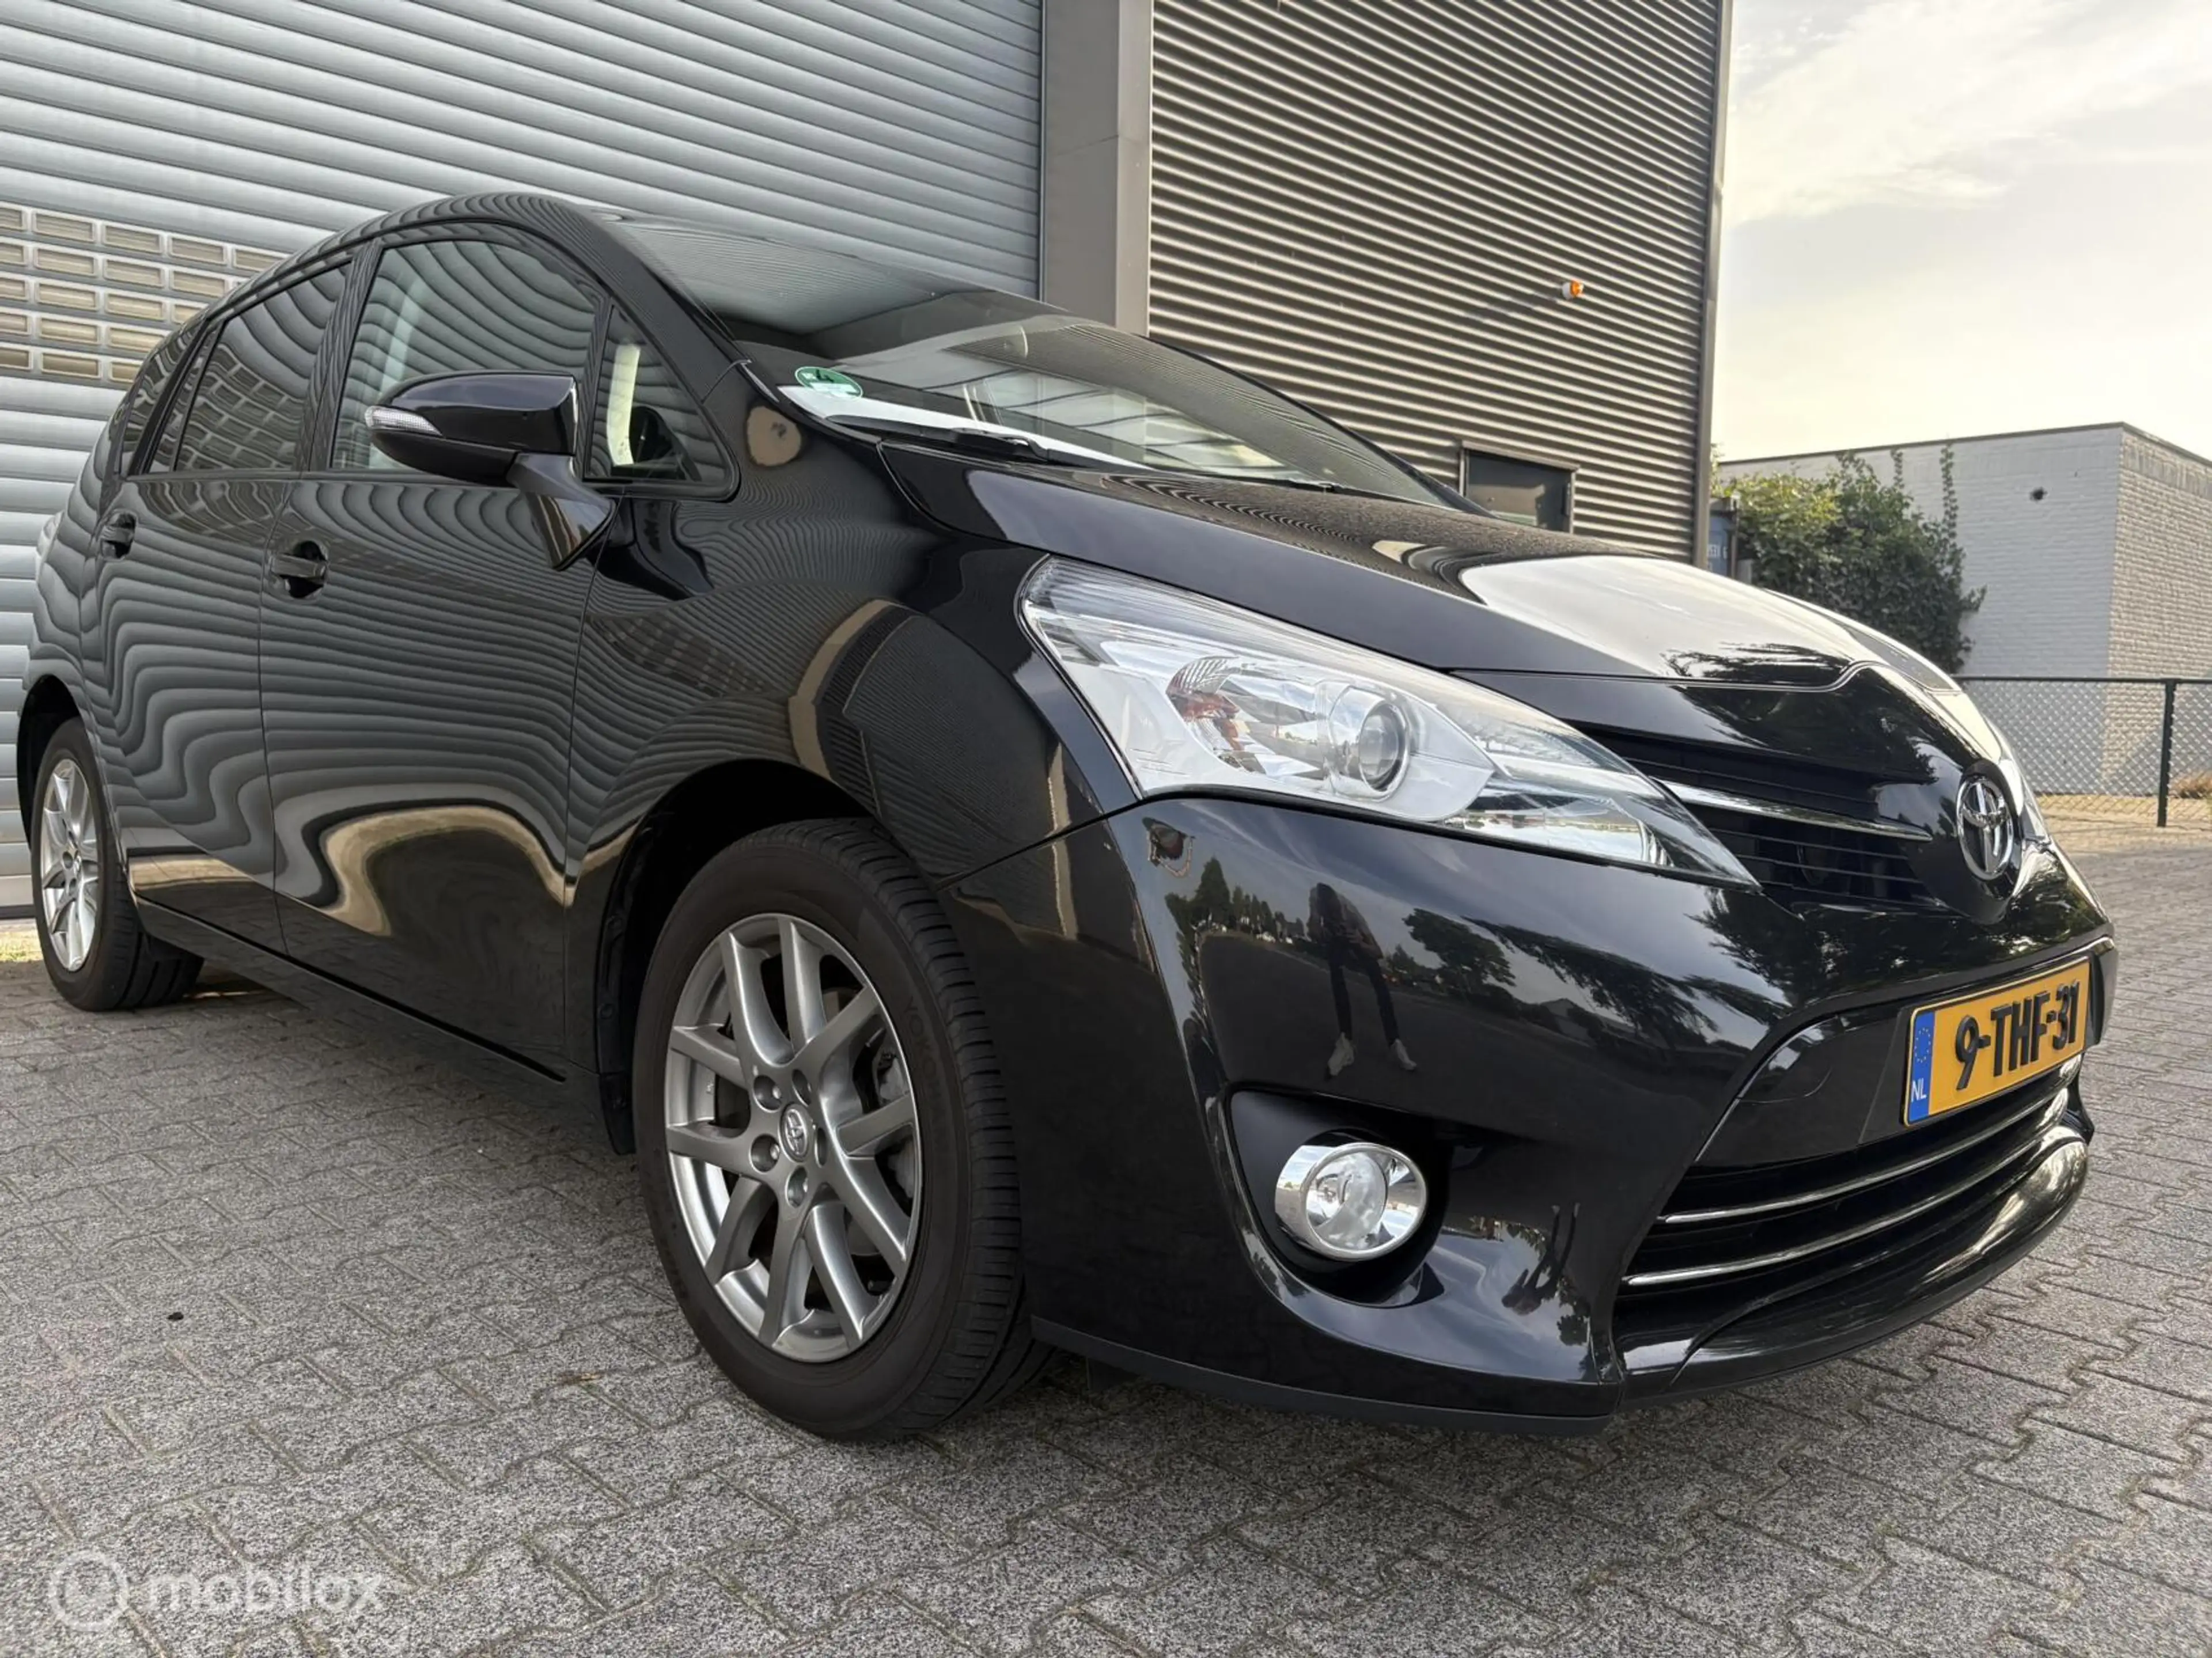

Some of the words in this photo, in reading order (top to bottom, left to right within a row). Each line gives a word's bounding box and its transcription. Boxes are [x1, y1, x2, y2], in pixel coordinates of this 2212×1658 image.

[904, 995, 950, 1175] YOKOHA
[1955, 980, 2080, 1090] 9-THF-31
[1911, 1079, 1927, 1102] NL
